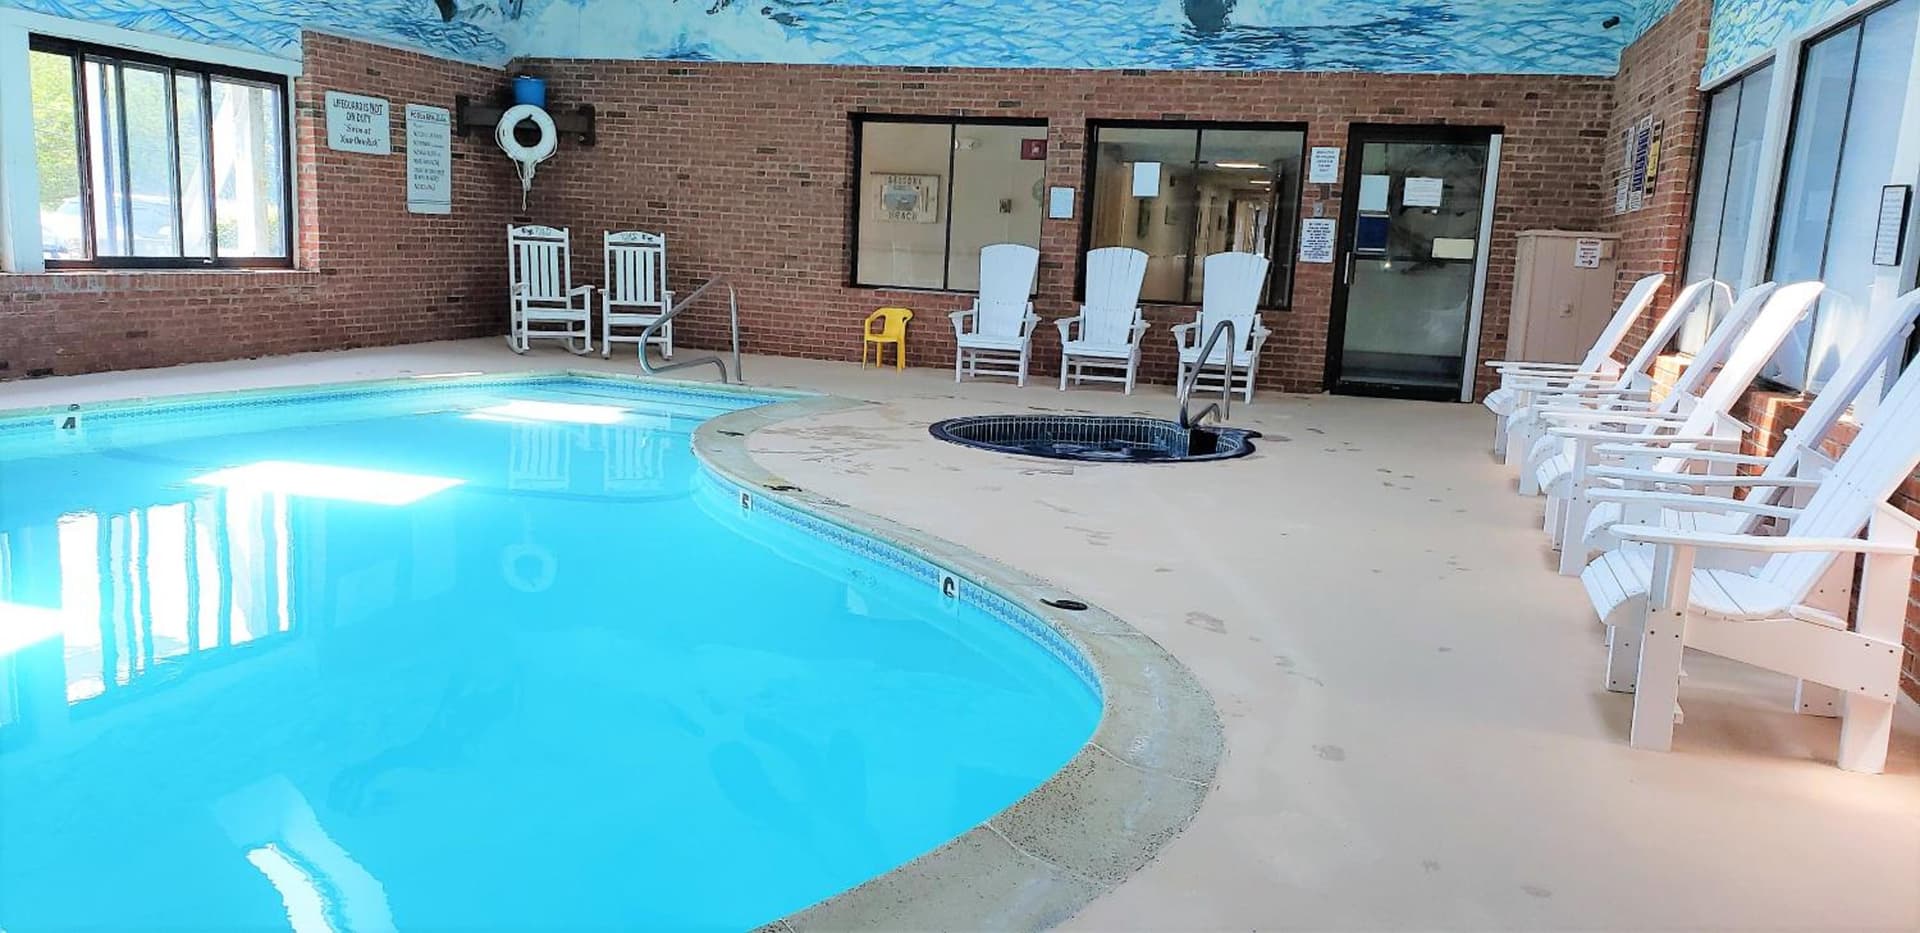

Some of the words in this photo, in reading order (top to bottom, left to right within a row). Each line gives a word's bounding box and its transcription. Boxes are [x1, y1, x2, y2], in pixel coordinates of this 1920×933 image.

[363, 103, 369, 112] IS
[370, 102, 383, 114] NOT
[346, 111, 355, 121] ON
